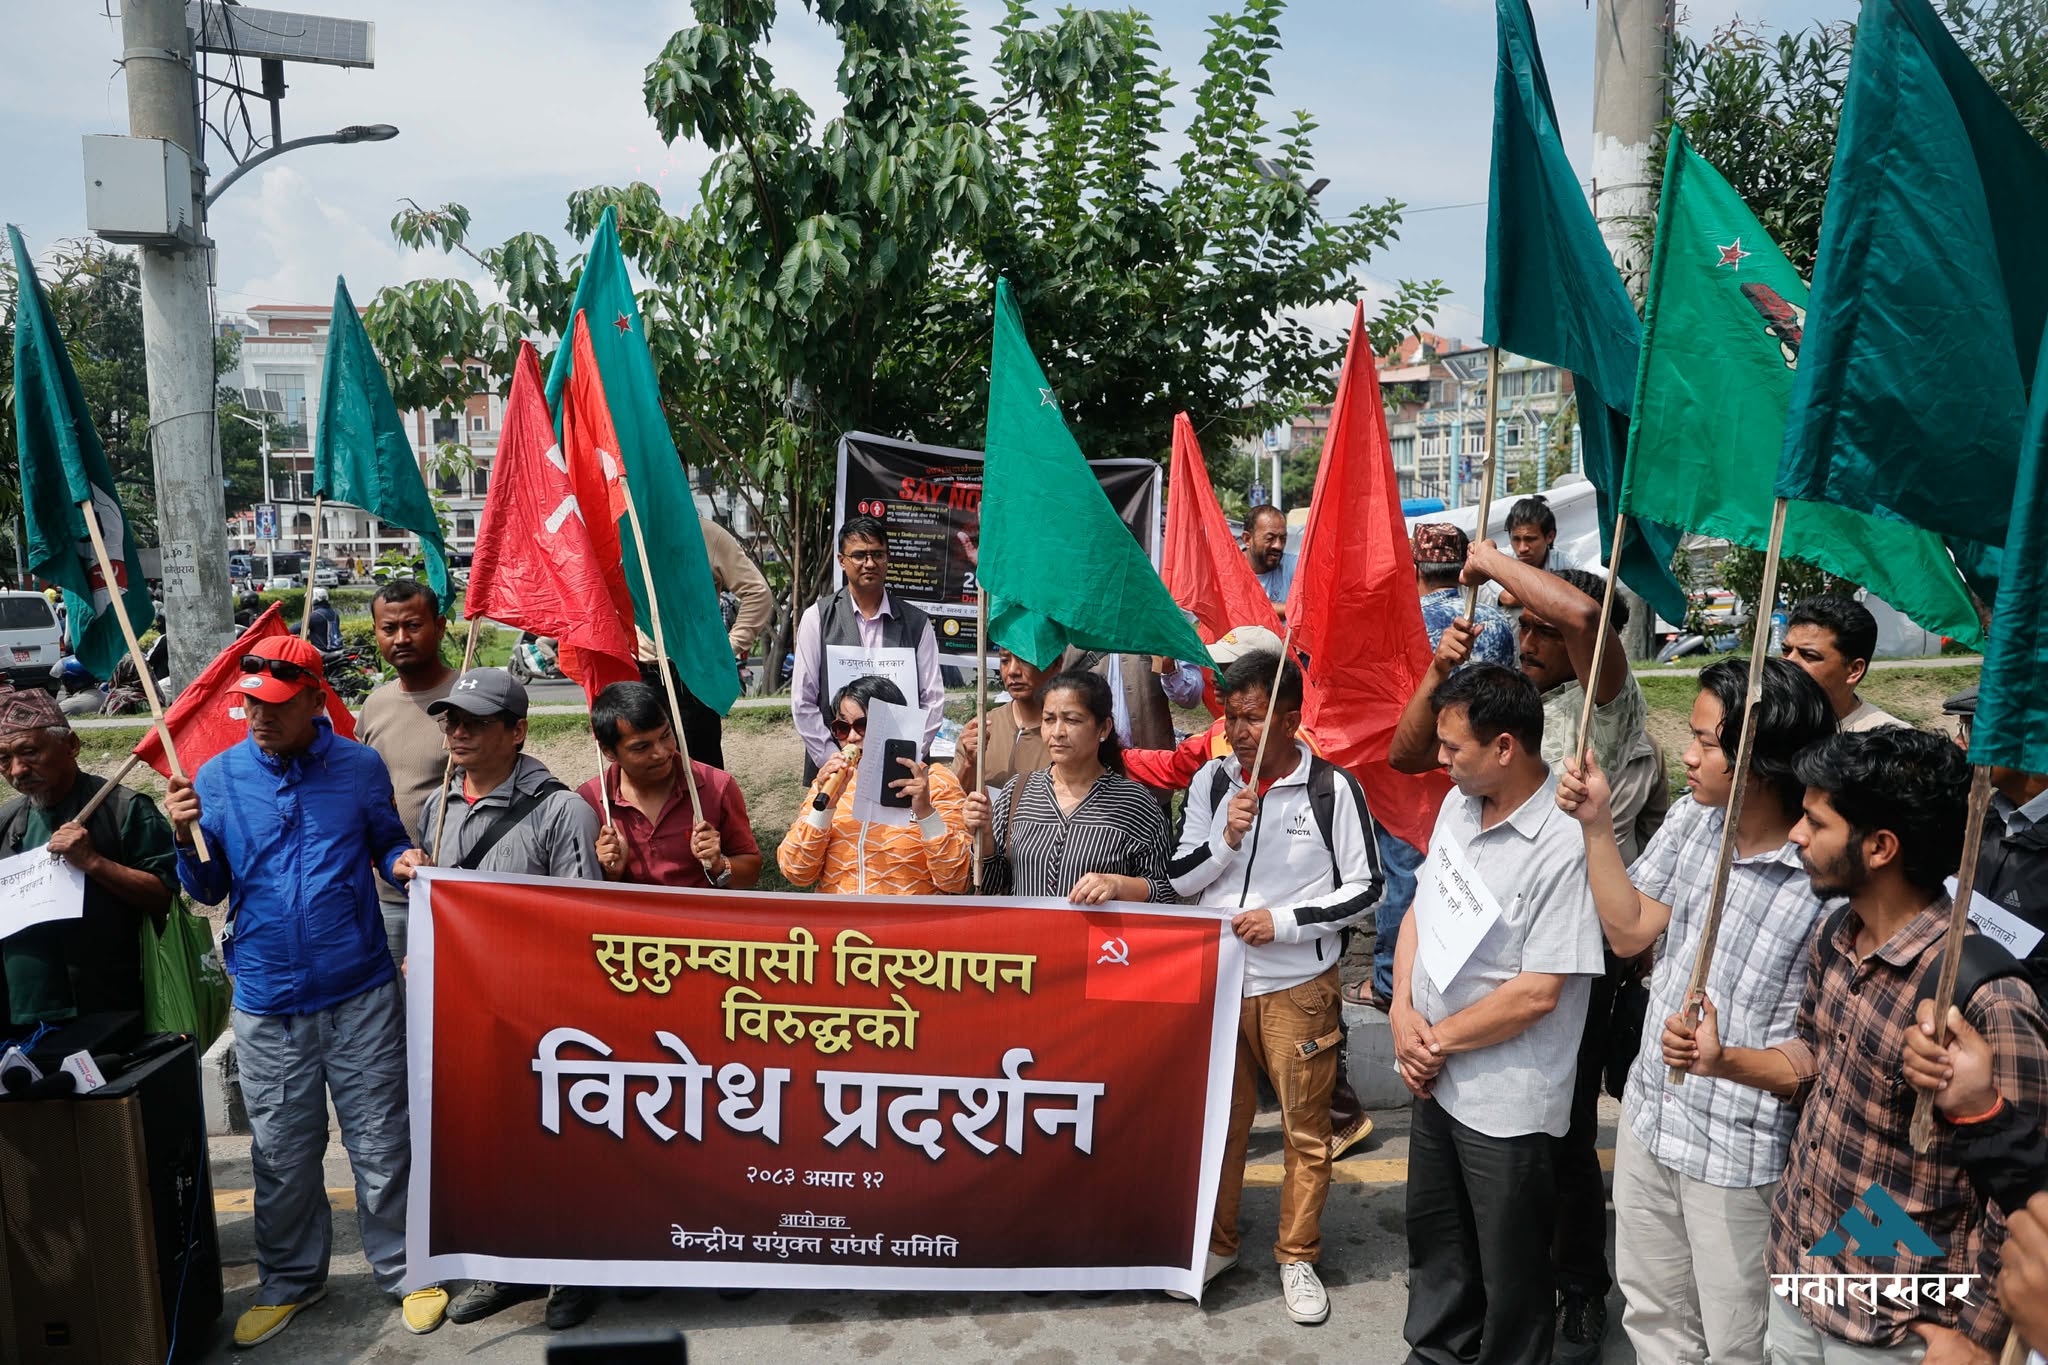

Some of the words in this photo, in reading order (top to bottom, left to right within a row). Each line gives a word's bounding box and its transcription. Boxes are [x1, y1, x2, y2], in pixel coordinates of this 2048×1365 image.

[898, 477, 944, 505] SAY
[961, 594, 978, 603] Dru
[878, 660, 904, 668] सरकार
[1286, 828, 1311, 836] NOCTA
[592, 927, 819, 994] सुकुम्बासी
[832, 929, 1037, 995] विस्थापन
[721, 985, 919, 1053] विरुद्धको
[532, 1026, 791, 1145] विरोध
[816, 1047, 1104, 1160] प्रदर्शन
[746, 1166, 795, 1186] २०८३
[802, 1170, 856, 1189] असार
[862, 1171, 884, 1189] १२
[779, 1211, 846, 1227] आयोजक
[671, 1224, 745, 1253] केन्द्रीय
[891, 1235, 959, 1257] समिति
